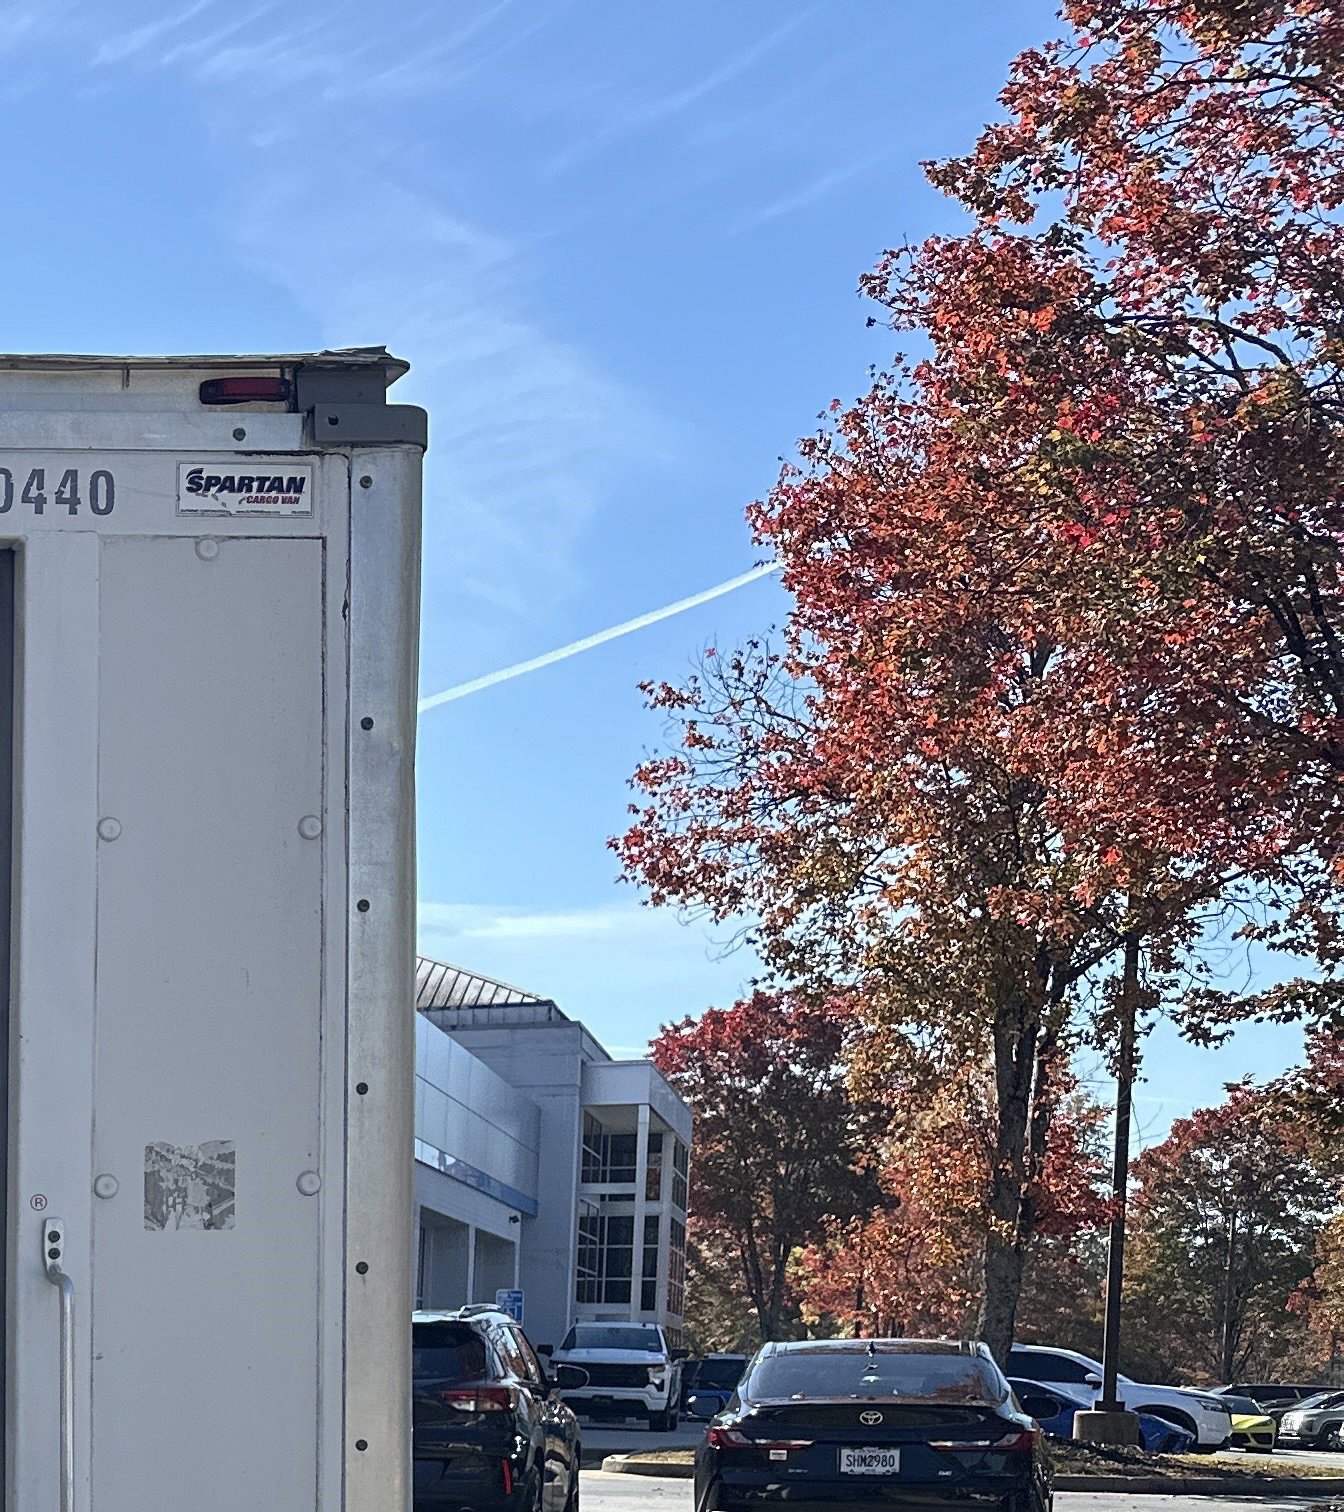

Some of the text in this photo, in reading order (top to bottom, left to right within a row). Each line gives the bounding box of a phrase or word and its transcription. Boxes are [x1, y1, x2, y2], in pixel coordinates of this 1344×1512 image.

[185, 467, 305, 494] SPARTAN
[245, 495, 301, 505] CARGO VAN
